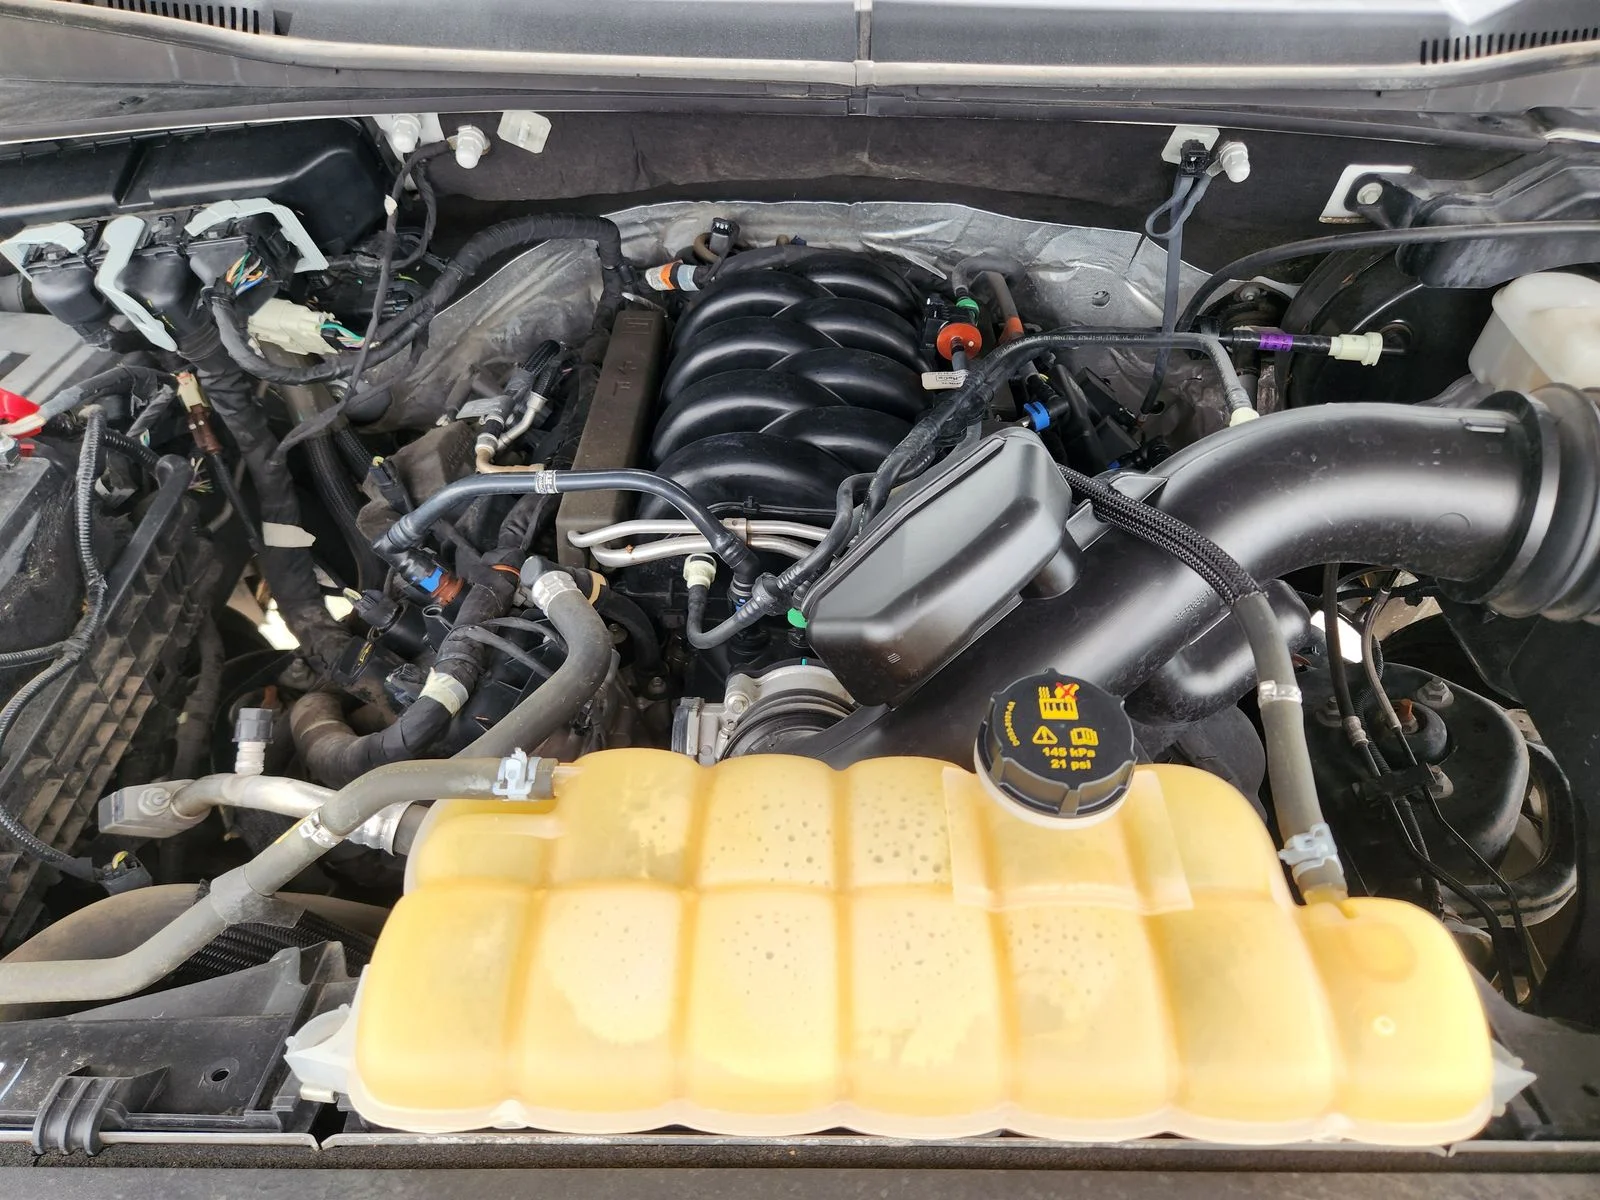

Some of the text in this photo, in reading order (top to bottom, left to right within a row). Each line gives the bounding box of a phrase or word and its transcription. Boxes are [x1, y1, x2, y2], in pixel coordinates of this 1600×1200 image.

[1042, 747, 1096, 757] 145 kPa
[1050, 759, 1091, 771] 21 psi
